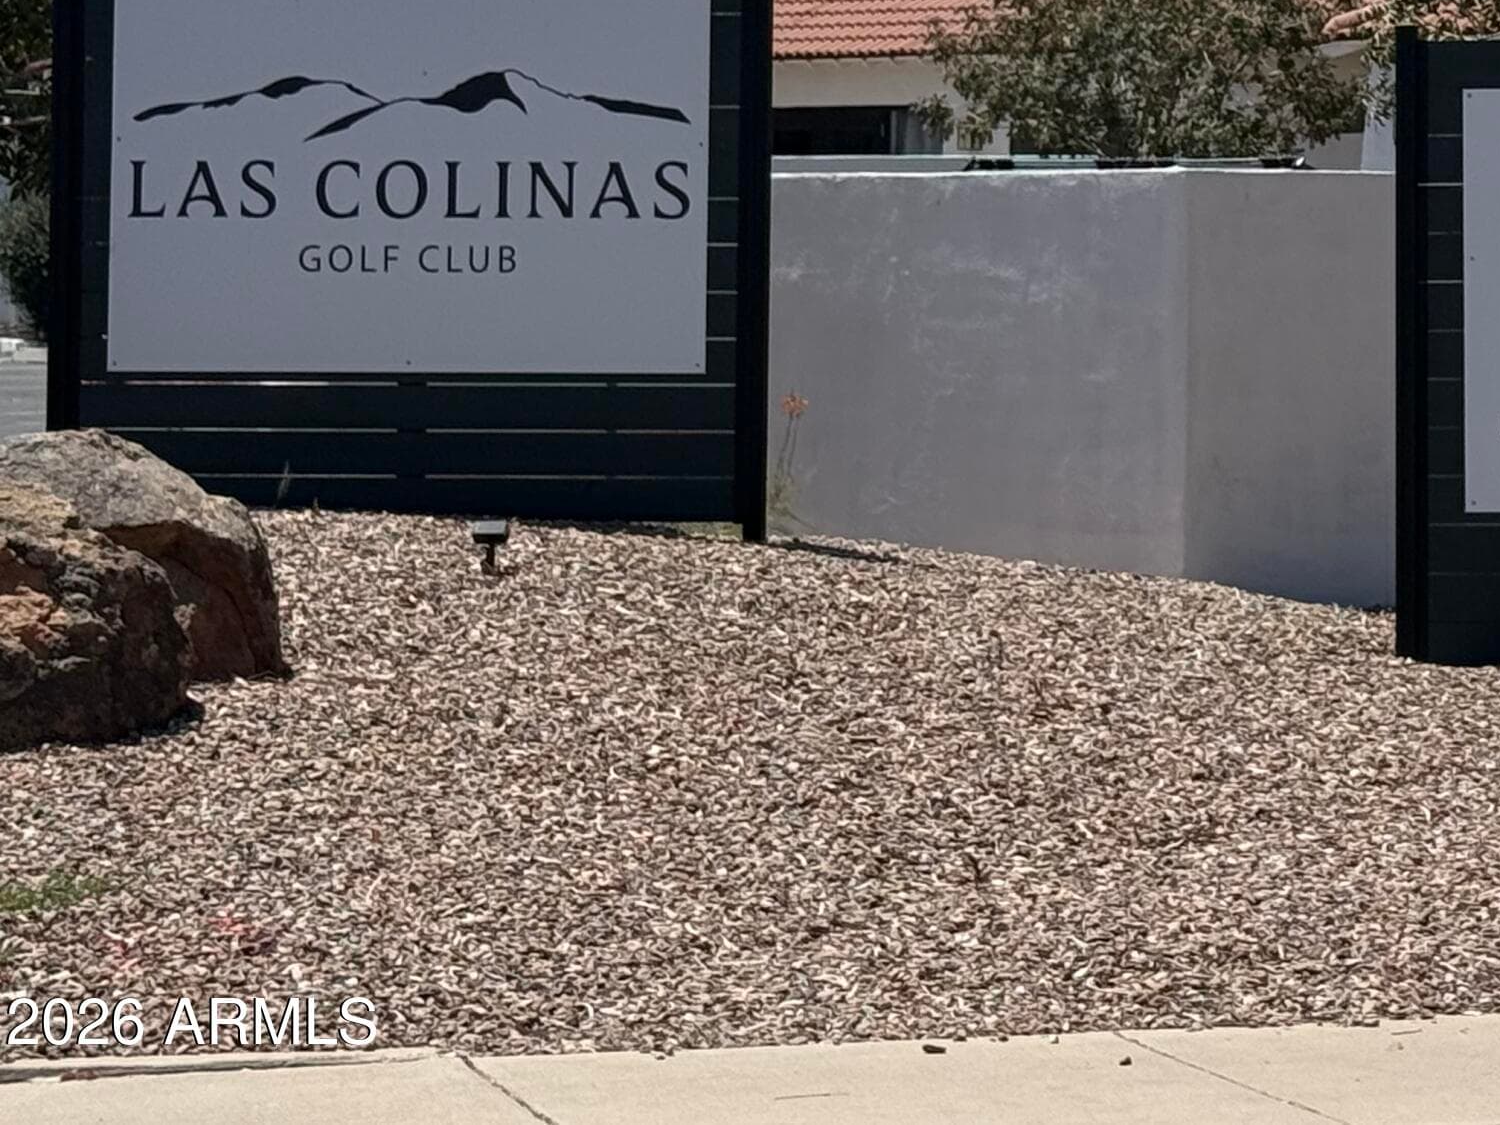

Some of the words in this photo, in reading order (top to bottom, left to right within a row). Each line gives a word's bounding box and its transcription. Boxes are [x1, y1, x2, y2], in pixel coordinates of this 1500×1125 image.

[128, 160, 277, 219] LAS
[316, 160, 690, 220] COLINAS
[299, 244, 400, 274] GOLF
[419, 245, 517, 274] CLUB
